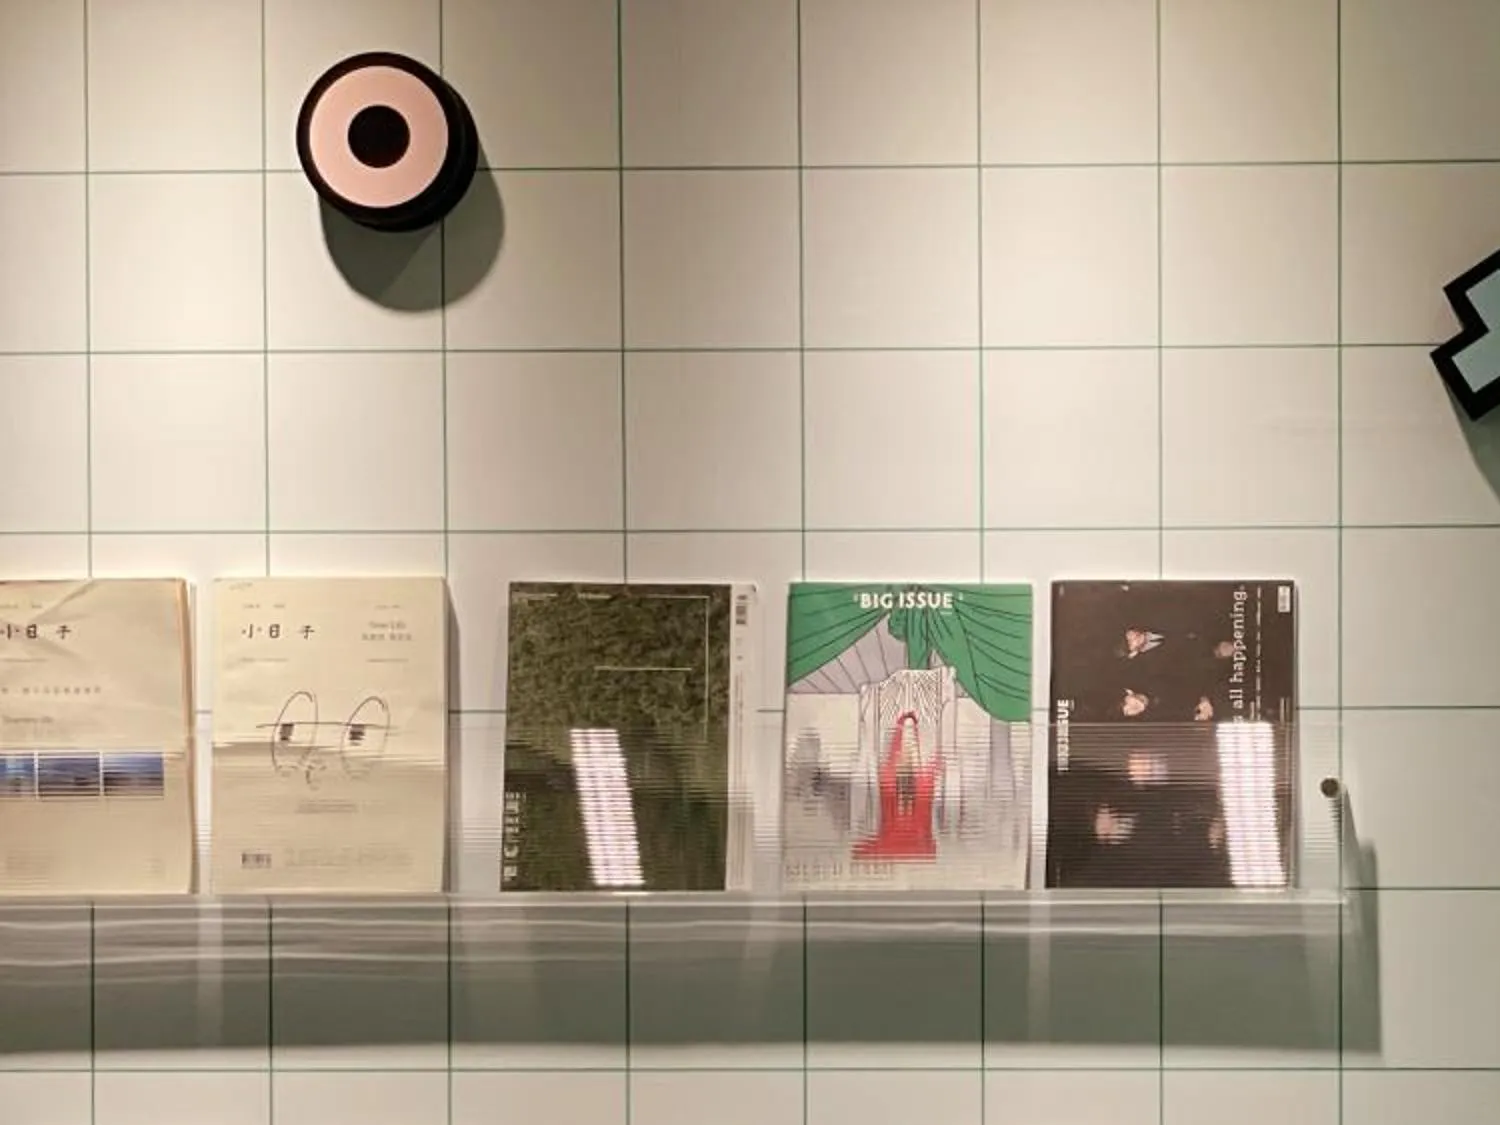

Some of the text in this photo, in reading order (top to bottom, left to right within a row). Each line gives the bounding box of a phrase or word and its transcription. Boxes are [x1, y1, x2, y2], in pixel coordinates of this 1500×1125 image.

[860, 591, 953, 609] BIG ISSUE
[241, 623, 315, 640] 小日子
[1229, 689, 1243, 709] all
